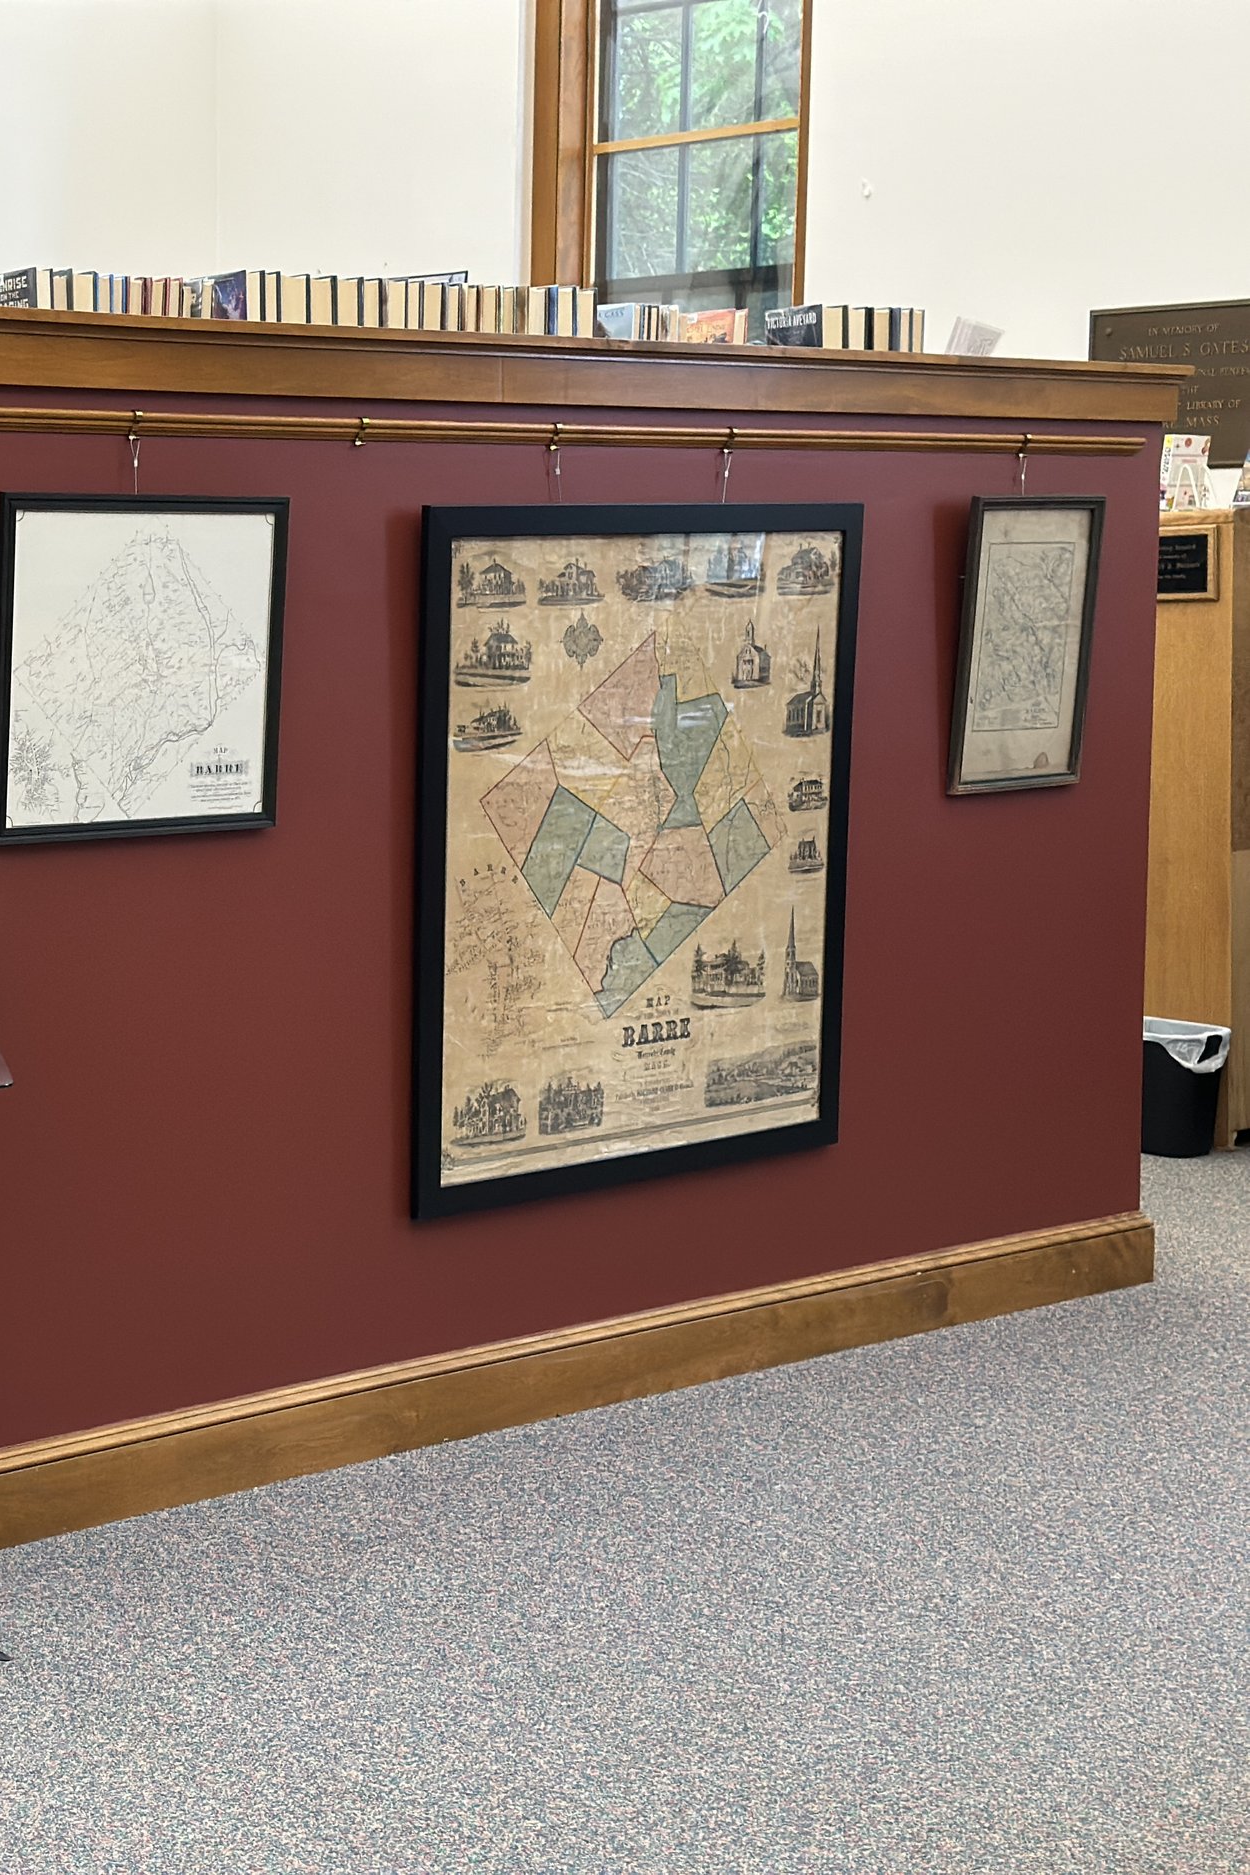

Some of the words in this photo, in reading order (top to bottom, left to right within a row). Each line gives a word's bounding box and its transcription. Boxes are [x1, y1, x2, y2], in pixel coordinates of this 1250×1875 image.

[793, 312, 817, 326] AVEYARD
[1148, 327, 1158, 336] IN
[1163, 324, 1202, 335] MEMORY
[1206, 323, 1220, 333] OF
[1118, 343, 1177, 360] SAMUEL
[1200, 339, 1250, 356] GATES
[1187, 400, 1223, 410] LIBRARY
[1228, 399, 1241, 408] OF
[646, 995, 671, 1008] MAP
[621, 1017, 691, 1048] BARRE
